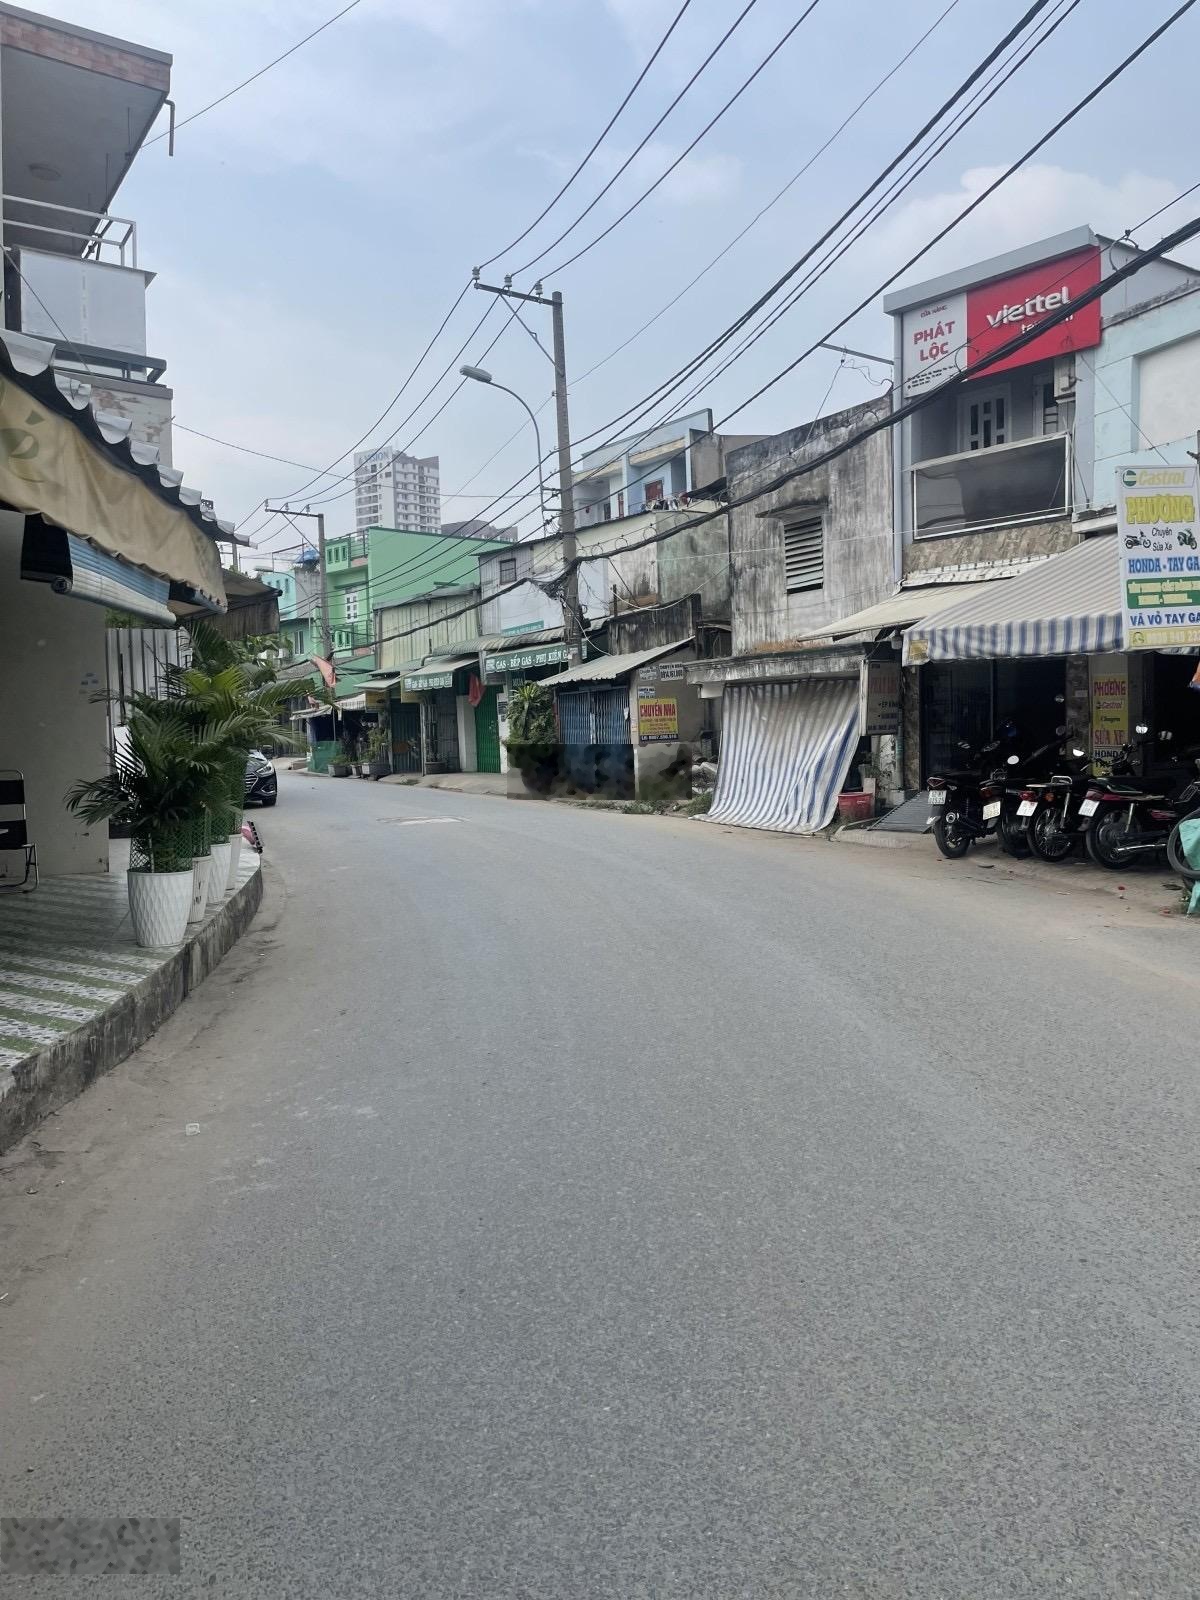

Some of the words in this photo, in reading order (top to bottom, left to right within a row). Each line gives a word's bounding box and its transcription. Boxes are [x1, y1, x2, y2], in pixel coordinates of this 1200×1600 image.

[986, 286, 1070, 328] viettel
[913, 321, 955, 345] PHÁT
[919, 342, 949, 362] LỘC
[1164, 542, 1173, 551] Xe
[1128, 558, 1162, 574] HONDA
[1167, 557, 1185, 572] TAY
[1186, 556, 1200, 572] GA
[1165, 613, 1186, 625] TAY
[496, 660, 507, 669] GAS
[521, 656, 532, 666] GAS
